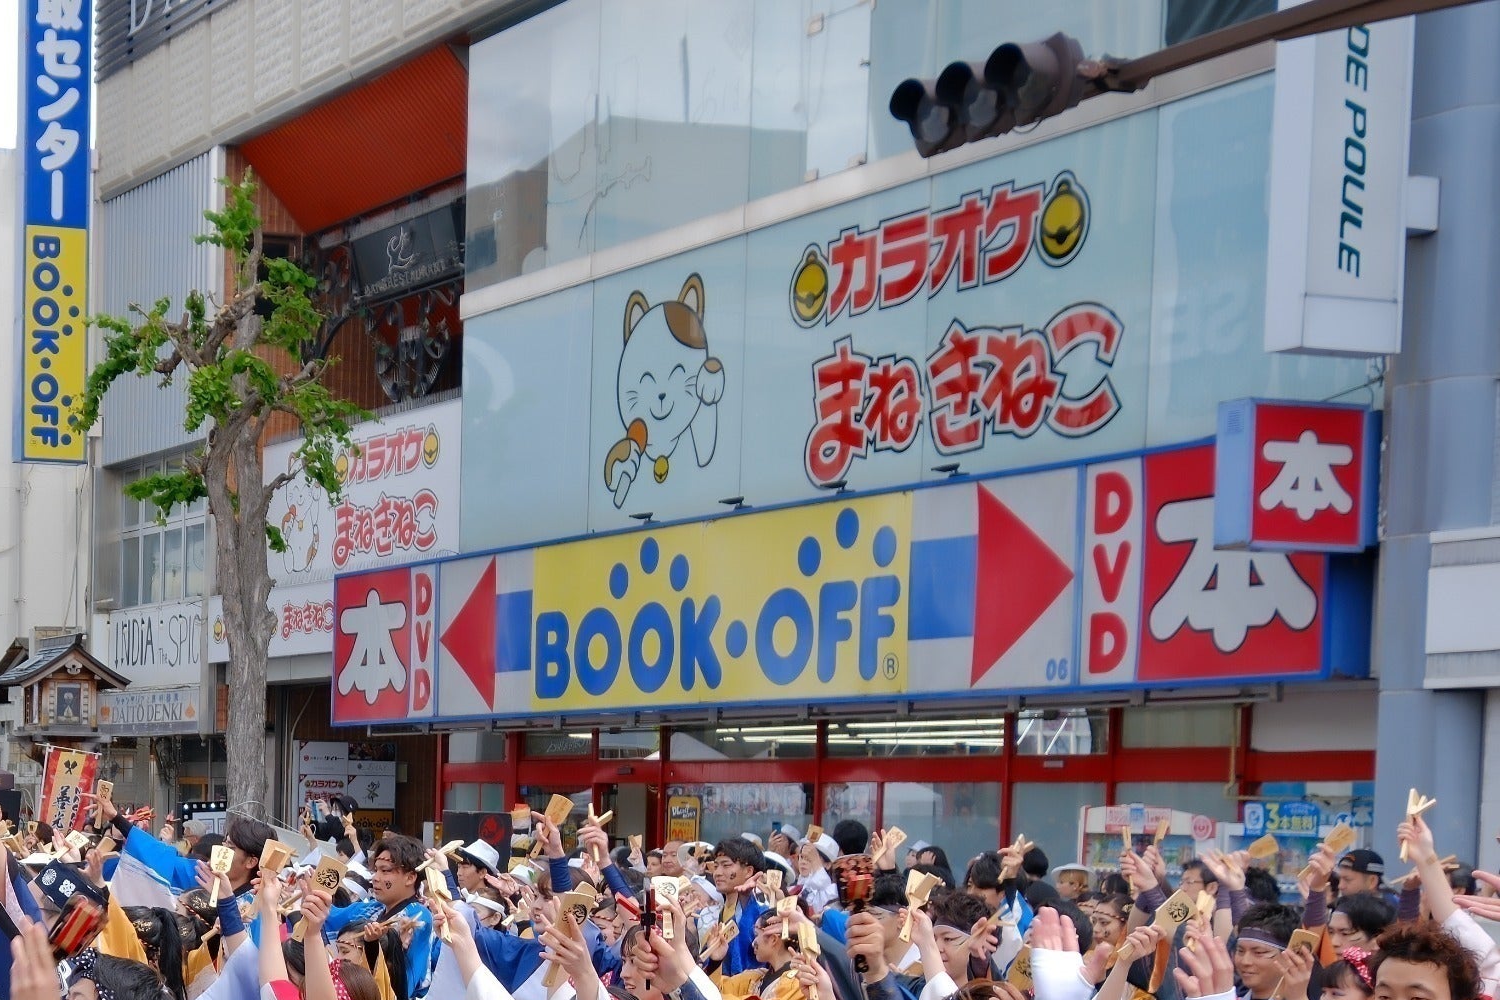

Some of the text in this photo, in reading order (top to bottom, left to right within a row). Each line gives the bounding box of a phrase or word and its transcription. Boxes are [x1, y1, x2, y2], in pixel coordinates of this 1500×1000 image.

[1337, 101, 1368, 278] POULE
[827, 182, 1046, 323] カラオケ
[805, 303, 1122, 485] まねきねこ
[348, 426, 425, 485] カラオケ
[1259, 429, 1353, 521] 本
[333, 488, 438, 569] まねきねこ
[1089, 471, 1133, 673] DVD
[1148, 496, 1318, 653] 本
[281, 599, 334, 640] まねきねこ
[338, 588, 407, 704] 本
[412, 572, 433, 712] DVD
[1046, 658, 1067, 680] 06
[147, 702, 182, 721] DENKI
